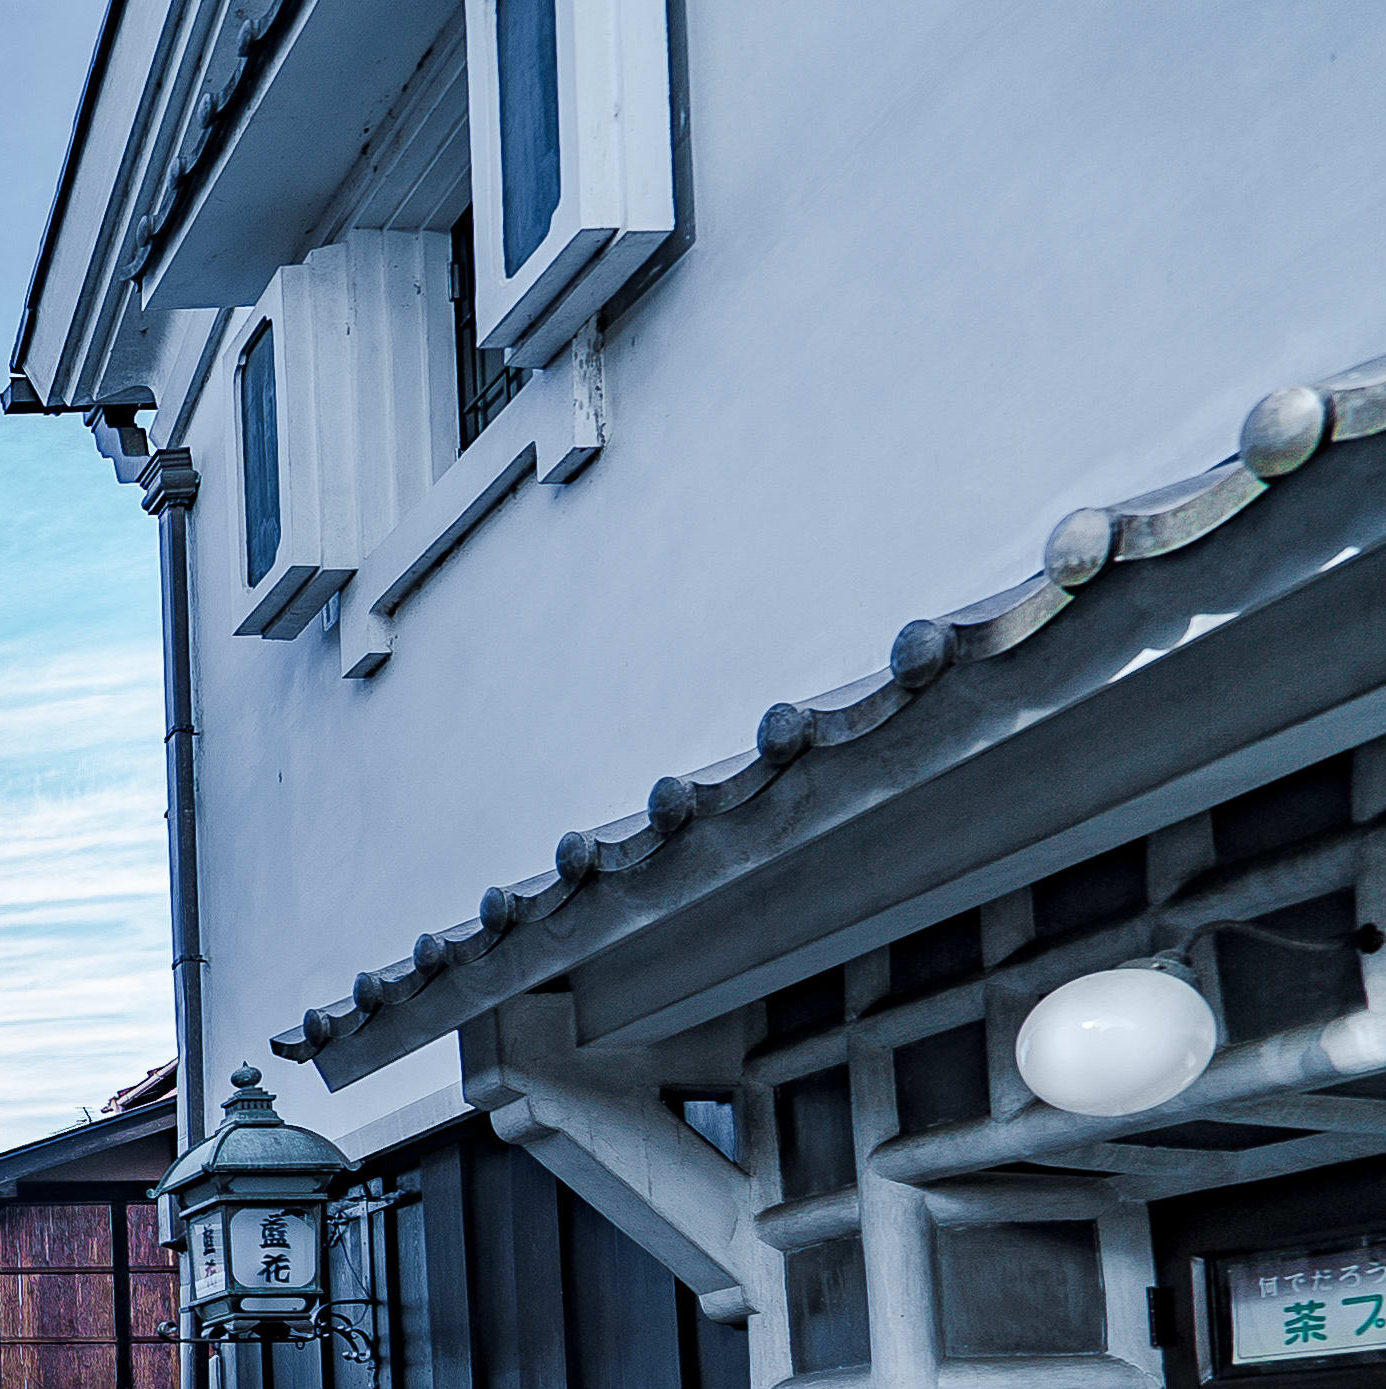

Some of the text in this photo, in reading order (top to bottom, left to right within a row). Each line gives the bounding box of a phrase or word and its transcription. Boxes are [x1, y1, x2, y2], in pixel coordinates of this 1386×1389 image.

[1259, 1262, 1386, 1298] 何でだろう
